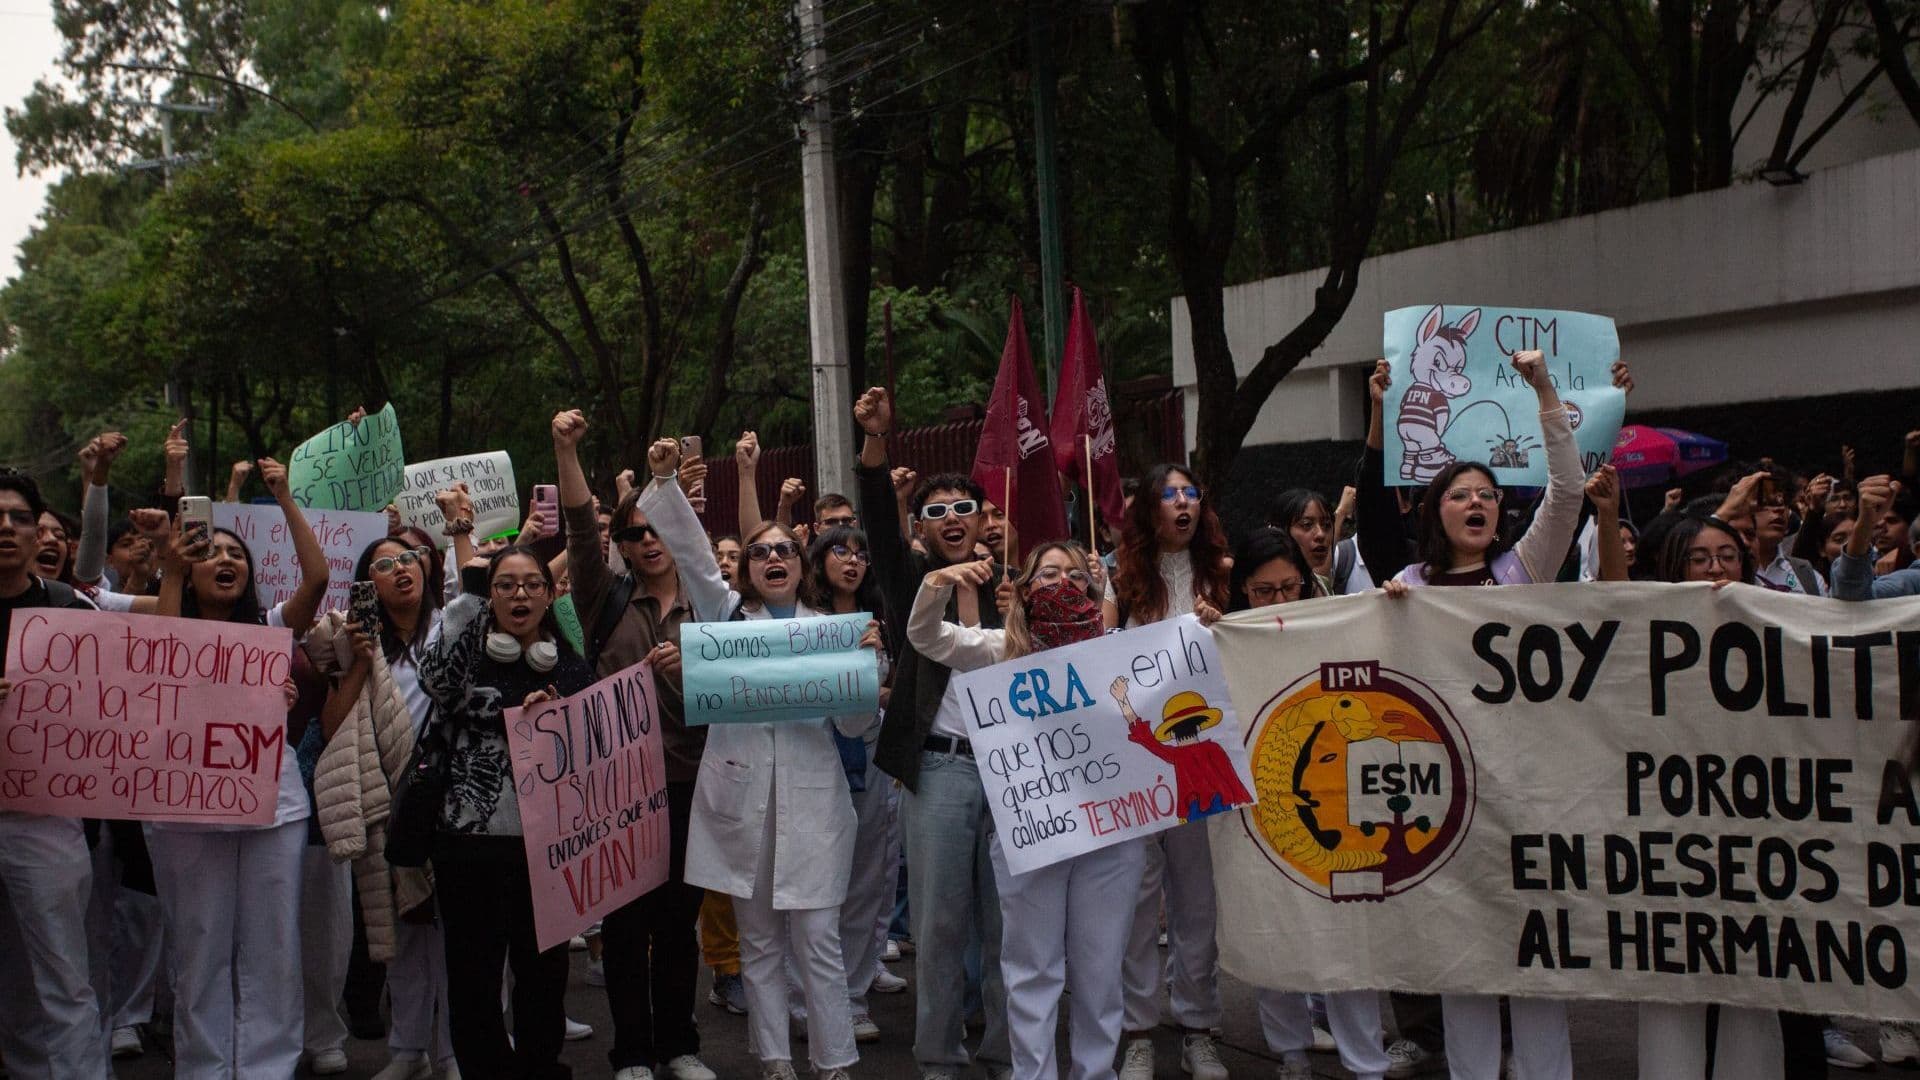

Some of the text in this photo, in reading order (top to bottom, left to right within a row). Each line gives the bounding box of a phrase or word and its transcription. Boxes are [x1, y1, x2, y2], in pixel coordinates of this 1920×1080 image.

[1495, 315, 1558, 357] CTM
[1406, 390, 1432, 404] IPN
[1568, 361, 1585, 390] la
[322, 419, 370, 454] IPN
[312, 457, 336, 482] SE
[415, 469, 440, 489] QUE
[461, 459, 496, 479] AMA
[474, 477, 505, 494] CUIDA
[234, 514, 255, 540] Ni
[311, 514, 354, 547] strés
[422, 509, 444, 527] POR
[255, 570, 287, 586] duele
[262, 548, 280, 567] de
[20, 614, 291, 687] Con tanto dinero
[700, 617, 864, 661] Somos BURROS
[966, 626, 1209, 729] La ERA en la
[1328, 666, 1373, 688] IPN
[1471, 619, 1621, 704] SOY
[99, 680, 128, 721] la
[138, 682, 187, 725] 4T
[696, 692, 723, 712] no
[535, 671, 650, 784] SI NO NOS
[166, 729, 192, 764] la
[202, 722, 284, 782] ESM
[988, 722, 1091, 783] que nos
[48, 771, 97, 801] cae
[131, 766, 258, 814] PEDAZOS
[555, 746, 657, 837] ESCUCHAN
[1002, 752, 1121, 822] quedamos
[1361, 763, 1441, 795] ESM
[1626, 751, 1853, 822] PORQUE
[548, 788, 669, 870] ENTONCES QUE NOS
[1012, 775, 1175, 849] callados TERMINÓ
[1510, 833, 1588, 891] EN
[1604, 831, 1840, 903] DESEOS
[1517, 908, 1907, 990] AL HERMANO
